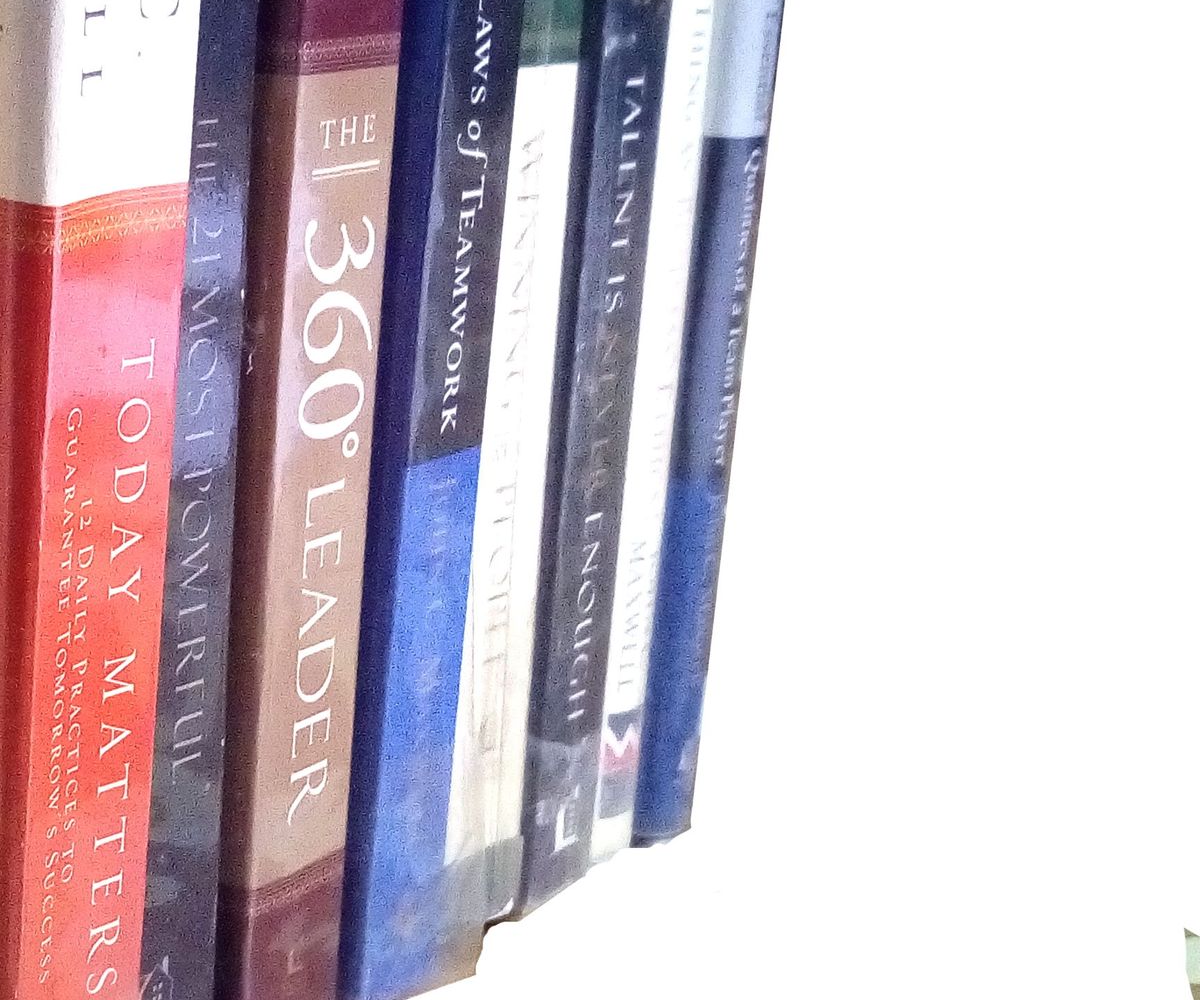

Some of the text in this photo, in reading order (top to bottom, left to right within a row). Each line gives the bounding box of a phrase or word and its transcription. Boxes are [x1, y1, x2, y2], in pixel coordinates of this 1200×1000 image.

[319, 113, 378, 150] THE
[456, 121, 486, 169] of
[608, 73, 646, 254] TALENT
[183, 283, 220, 441] MOST
[440, 174, 487, 433] TEAMWORK
[603, 274, 625, 313] IS
[71, 545, 93, 641] DAILY
[87, 337, 156, 995] TODAY MATTERS
[171, 465, 214, 775] POWERFUL
[287, 478, 346, 825] LEADER
[565, 513, 603, 723] ENOUGH
[614, 540, 648, 693] MAXWELL
[37, 407, 82, 985] GUARANTEE TOMORROW'S SUCCESS
[65, 658, 89, 831] PRACTICES
[60, 838, 75, 883] TO
